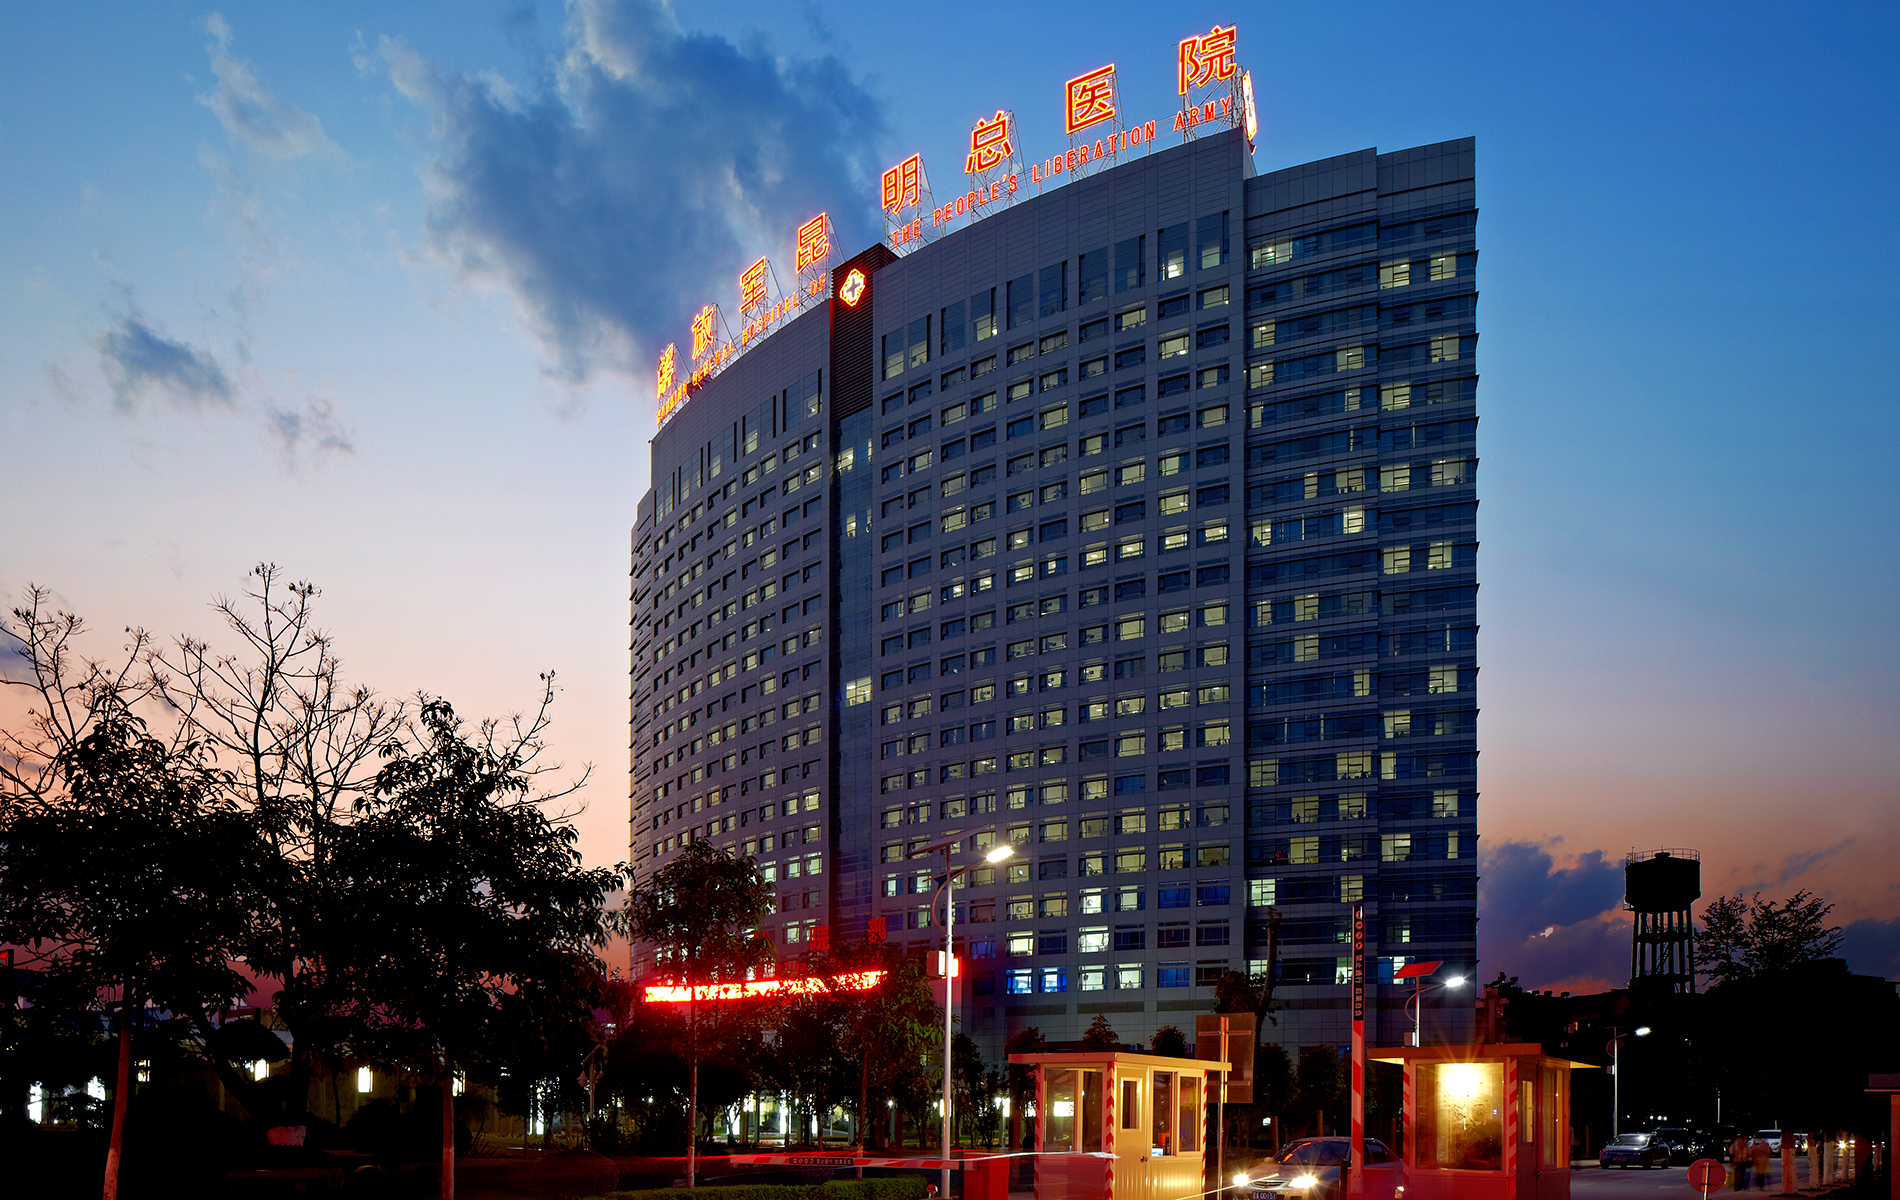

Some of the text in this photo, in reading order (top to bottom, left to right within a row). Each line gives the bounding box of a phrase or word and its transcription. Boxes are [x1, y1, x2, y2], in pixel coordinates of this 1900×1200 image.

[741, 291, 799, 345] HOSPITAL
[810, 273, 827, 296] OF
[891, 218, 921, 247] THE
[933, 173, 1018, 227] PEOPLE'S
[1032, 120, 1156, 183] LIBERATION
[1173, 95, 1231, 132] ARMY
